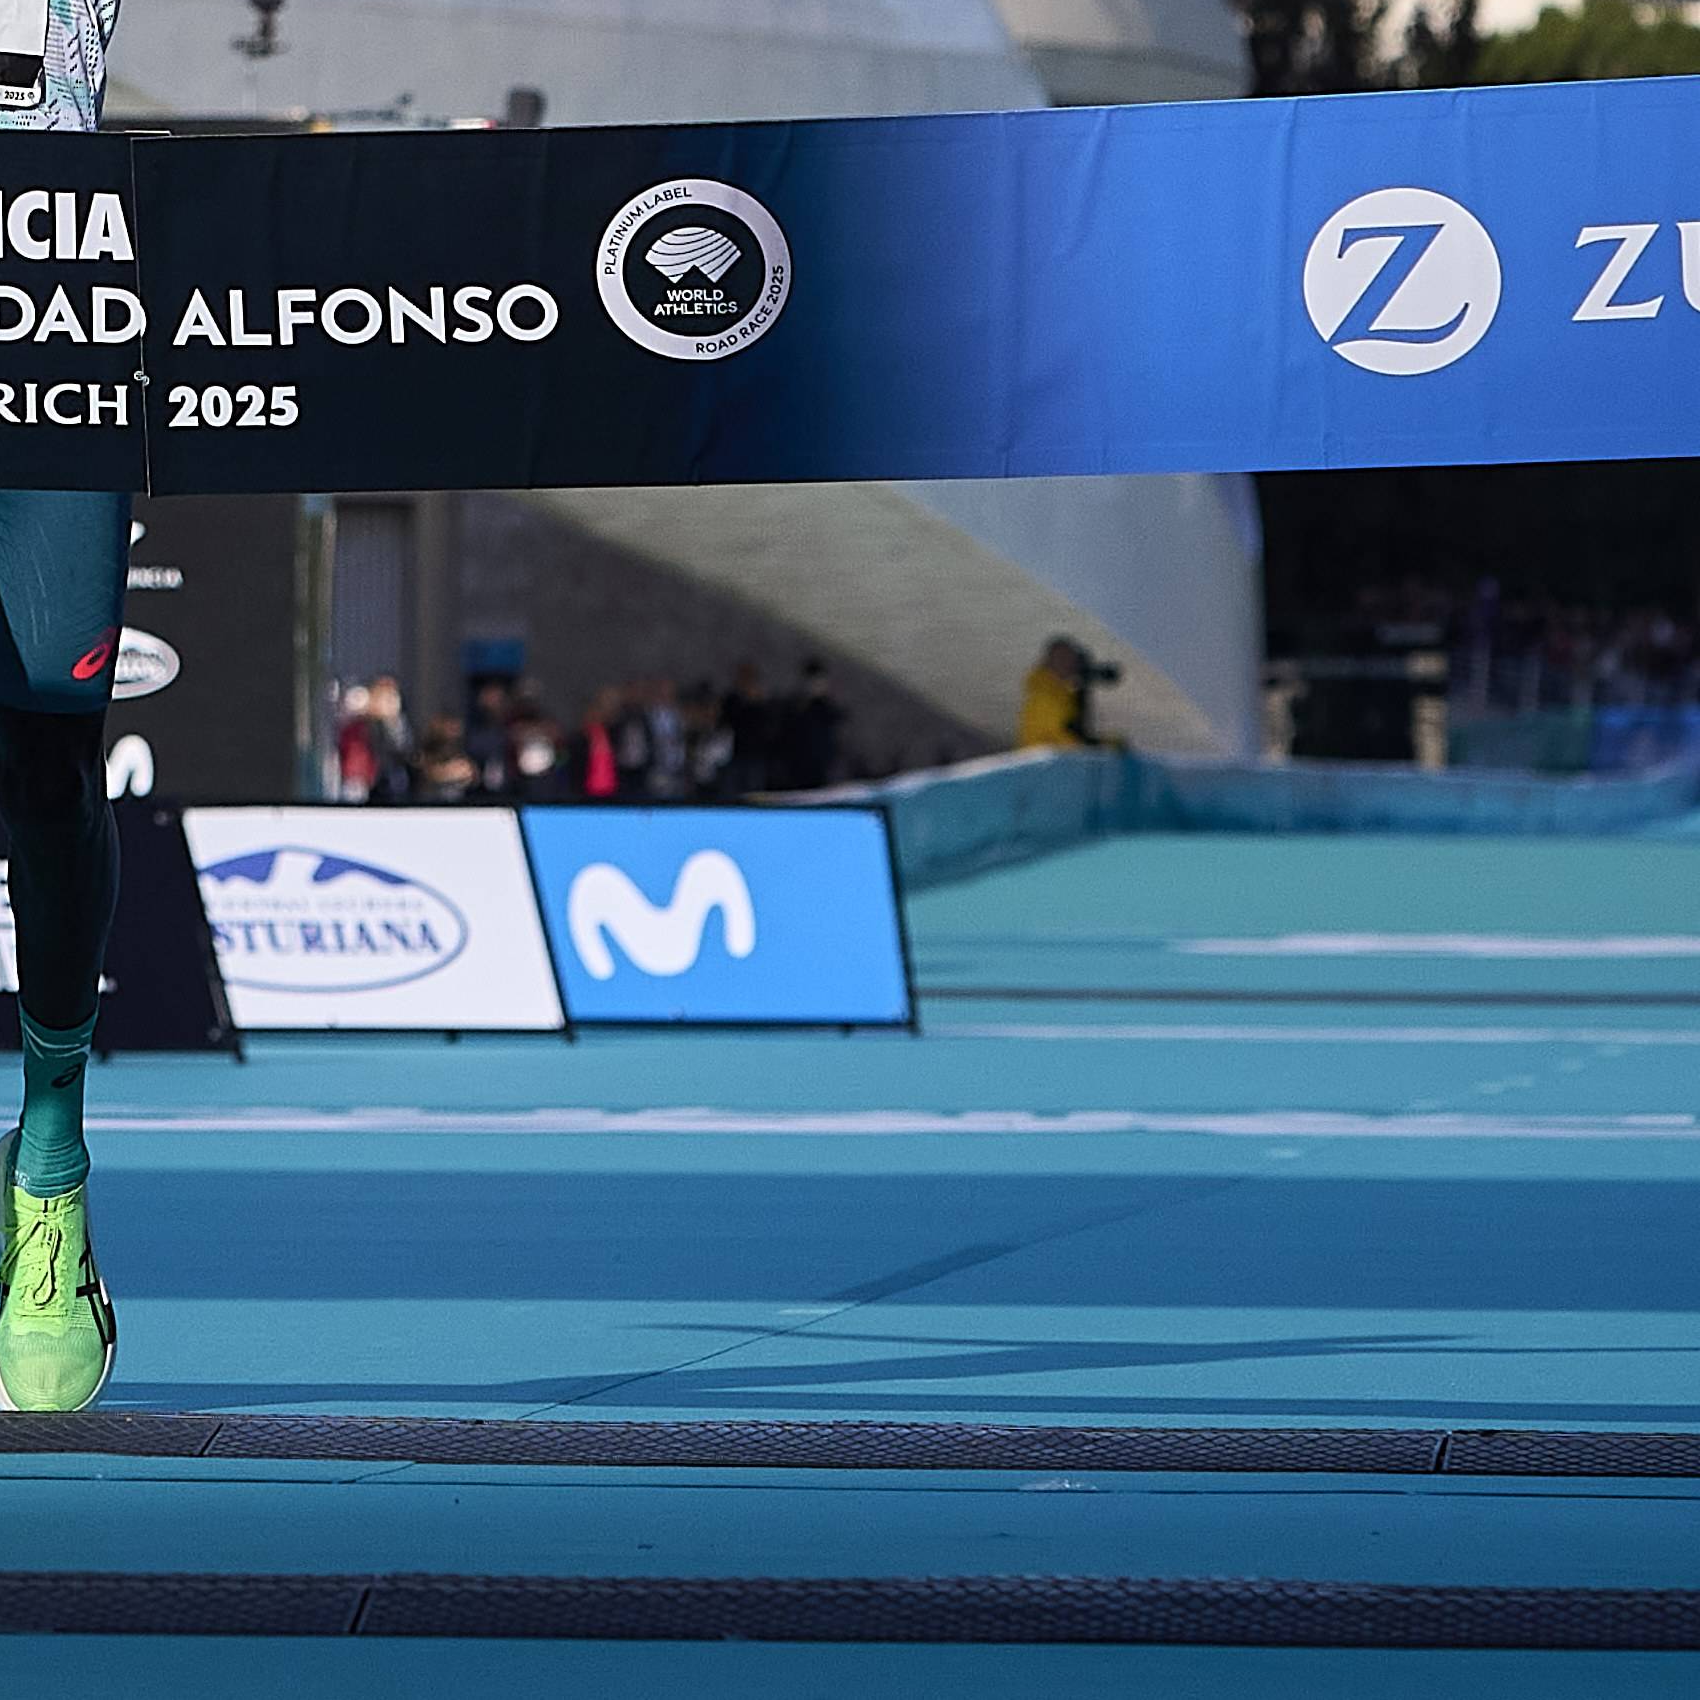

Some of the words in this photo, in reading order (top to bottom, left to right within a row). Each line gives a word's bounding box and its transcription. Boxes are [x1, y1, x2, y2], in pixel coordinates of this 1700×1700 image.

[605, 206, 645, 275] PLATINUM
[645, 187, 692, 209] LABEL
[172, 283, 559, 347] ALFONSO
[654, 301, 738, 316] ATHLETICS
[666, 288, 724, 302] WORLD
[695, 334, 739, 354] ROAD
[738, 307, 773, 340] RACE
[766, 264, 785, 306] 2025
[168, 384, 299, 429] 2025
